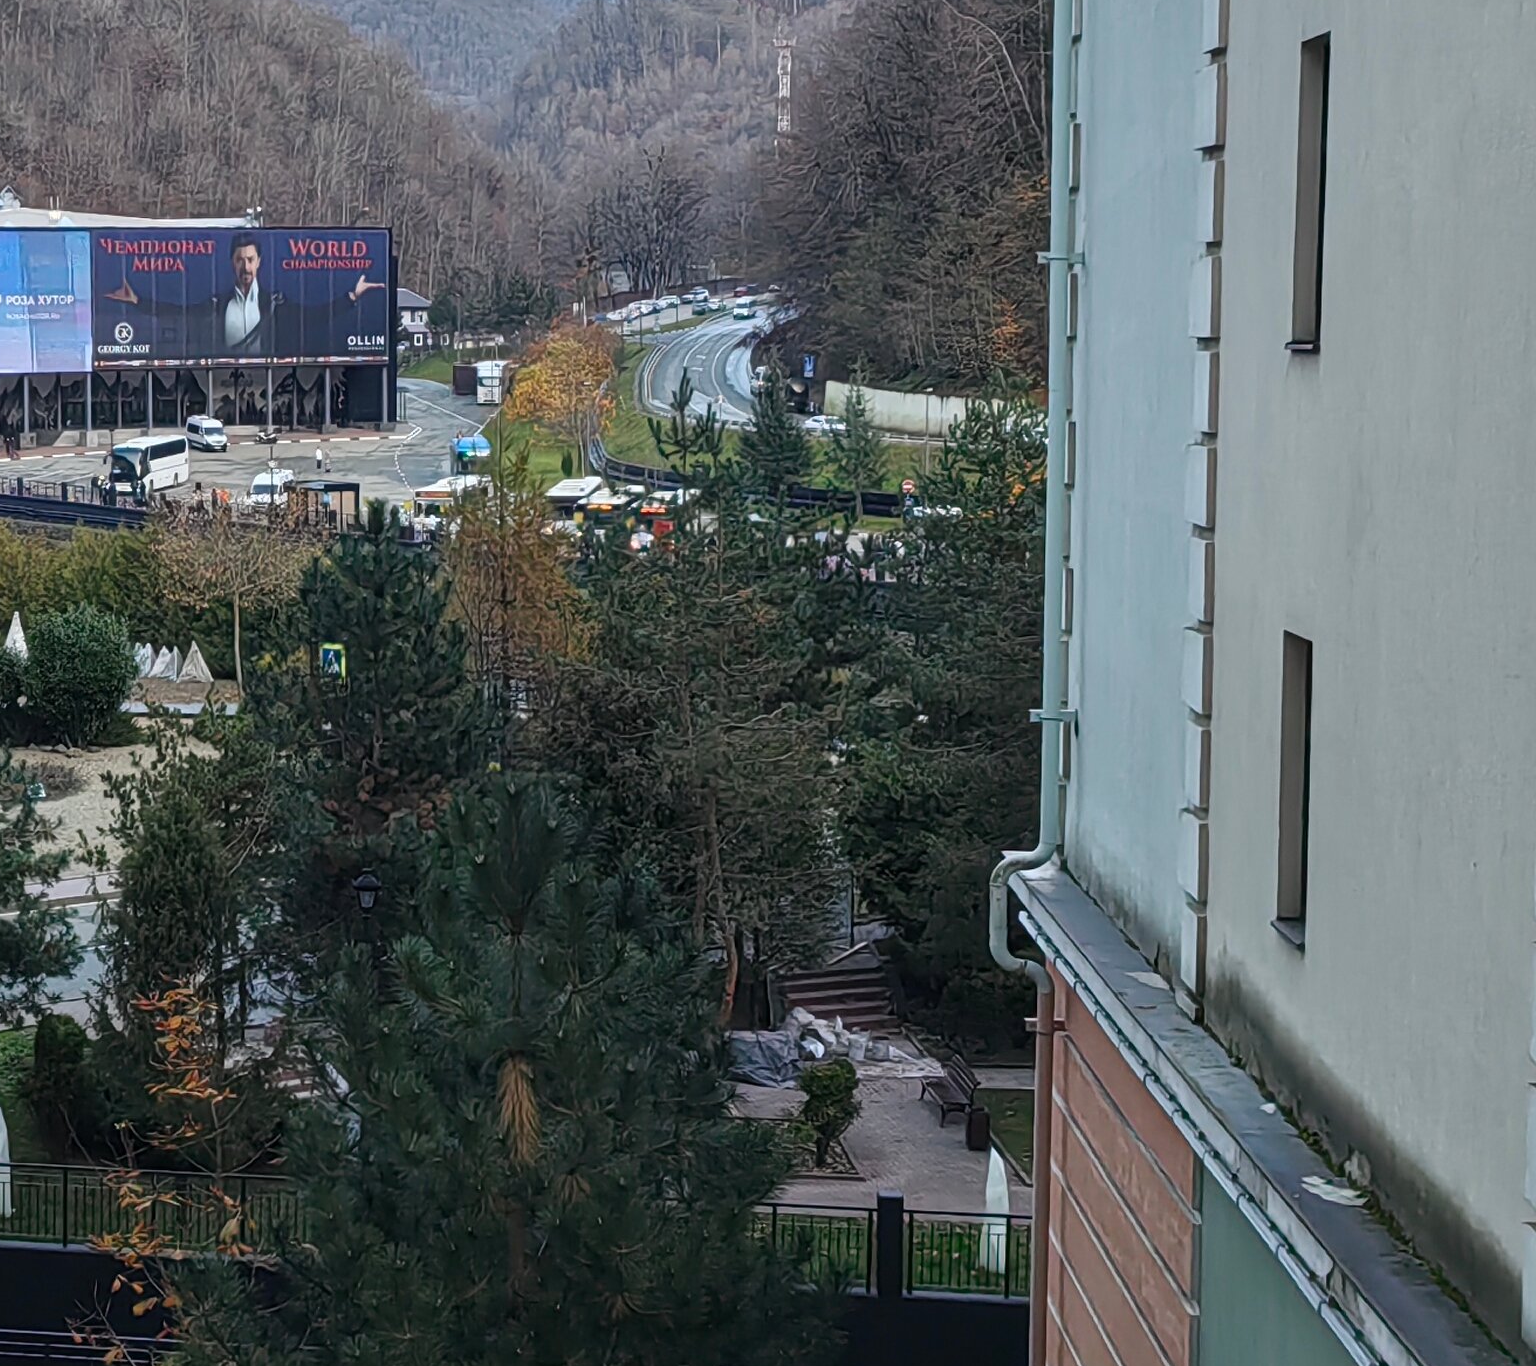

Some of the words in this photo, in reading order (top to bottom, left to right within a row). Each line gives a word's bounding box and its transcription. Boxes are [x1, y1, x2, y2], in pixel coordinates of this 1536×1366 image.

[99, 238, 216, 254] ЧЕМПИОНАТ
[288, 238, 367, 257] WORLD
[132, 256, 185, 271] МИРА
[282, 259, 372, 270] CHAMPIONSHIP
[5, 295, 35, 305] РОЗА
[38, 295, 75, 305] ХУТОР
[347, 335, 385, 346] OLLIN
